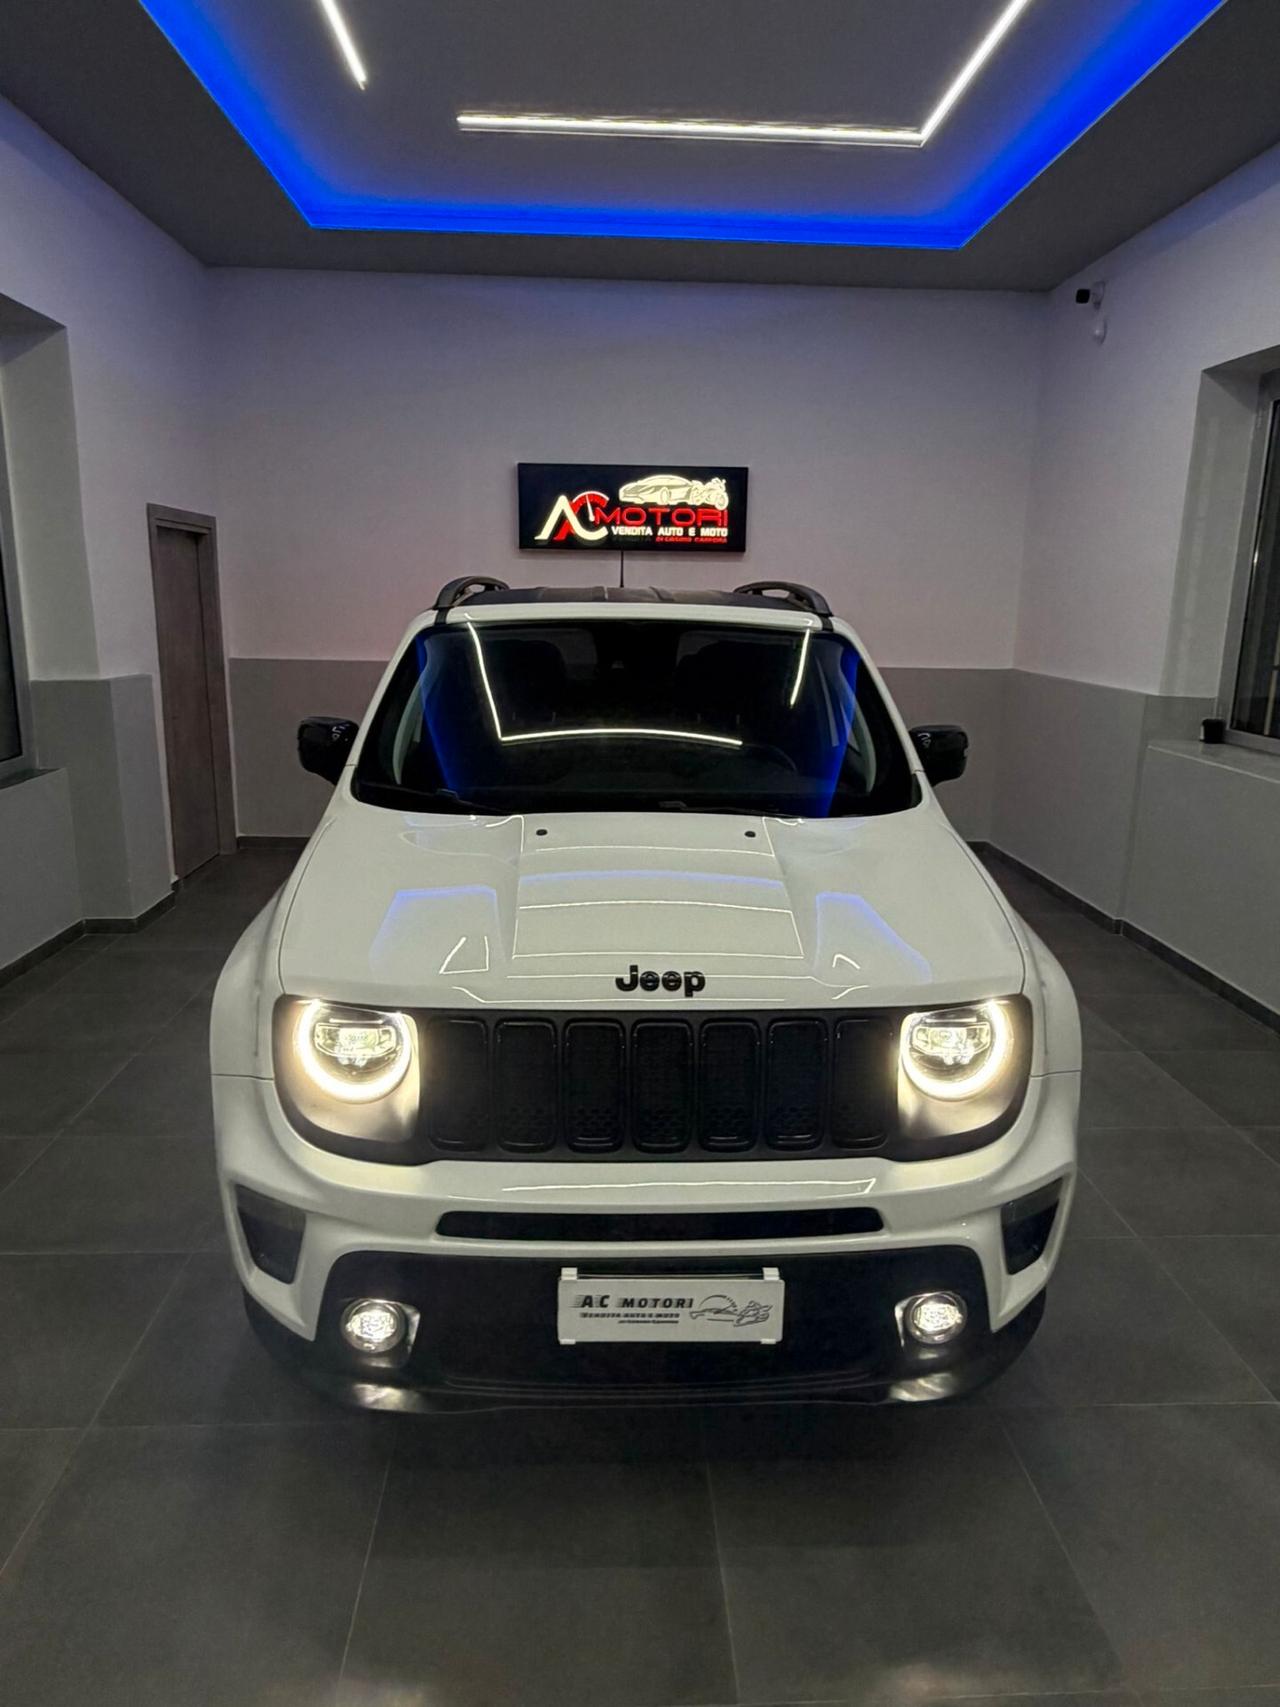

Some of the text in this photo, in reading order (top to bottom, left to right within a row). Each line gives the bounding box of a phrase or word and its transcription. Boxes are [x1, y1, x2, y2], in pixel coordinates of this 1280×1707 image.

[594, 506, 729, 527] MOTORI
[611, 526, 728, 537] VENDITA AUTO E MOTO
[615, 964, 706, 998] Jeep
[620, 1297, 694, 1309] MOTORI
